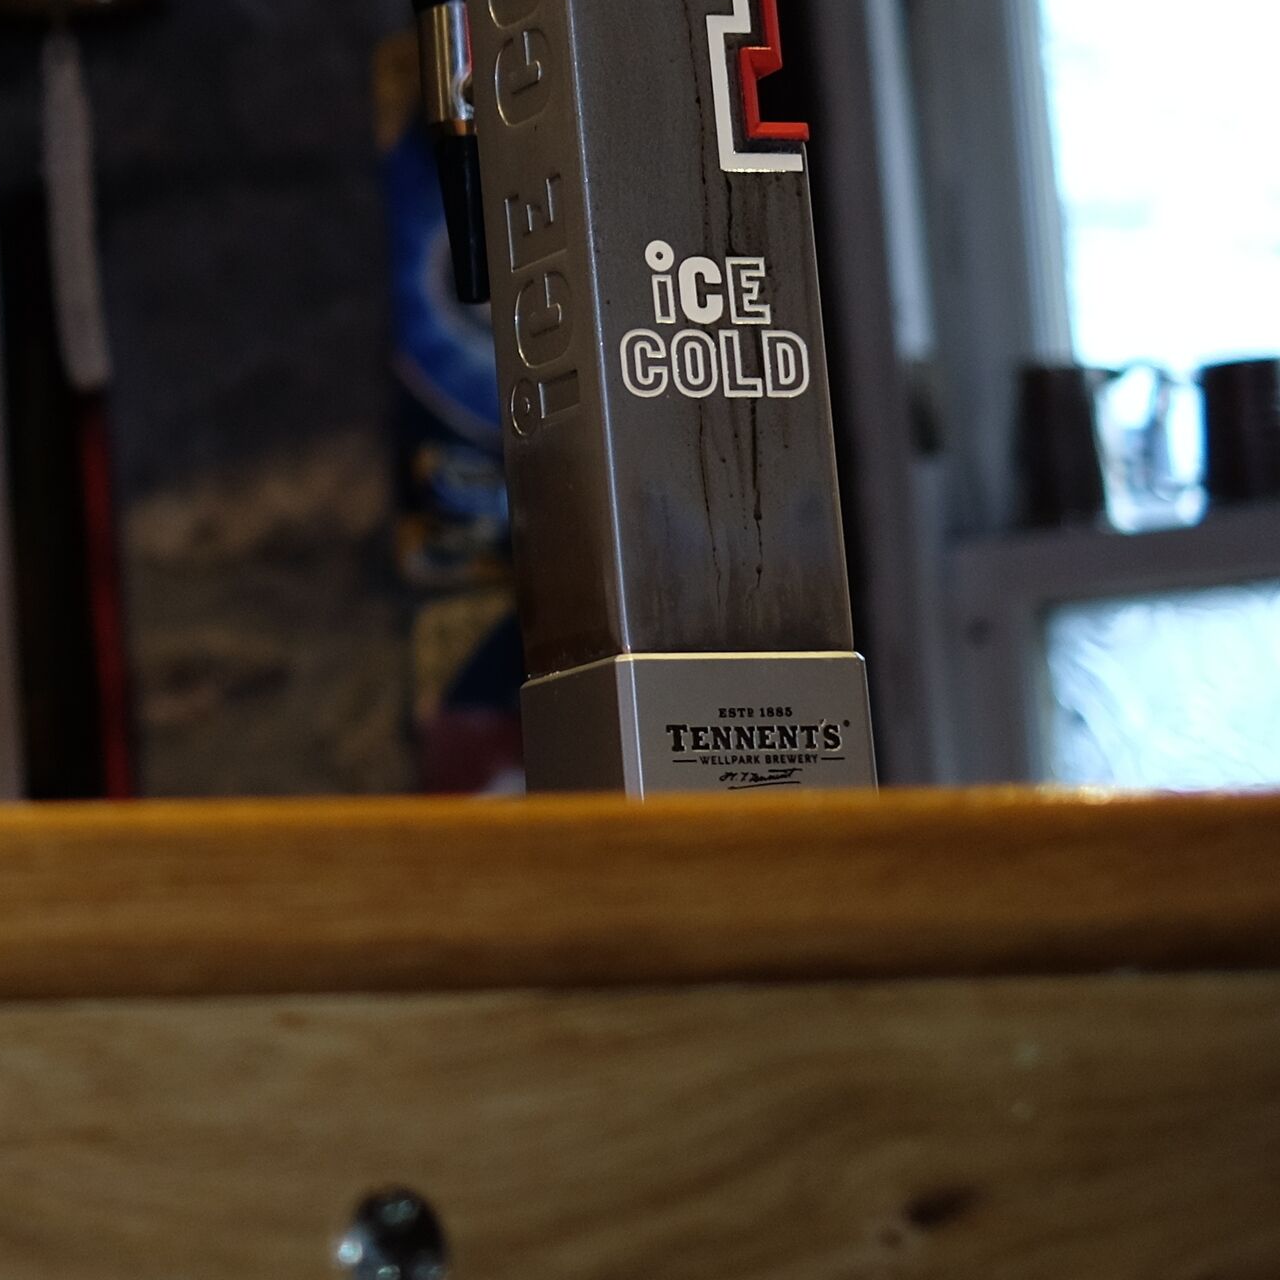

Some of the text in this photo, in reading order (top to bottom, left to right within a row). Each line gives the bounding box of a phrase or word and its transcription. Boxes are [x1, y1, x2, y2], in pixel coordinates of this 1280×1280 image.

[619, 328, 811, 398] COLD
[759, 706, 793, 717] 1885
[665, 719, 842, 752] TENNENT'S
[699, 753, 819, 765] WELLPARK BREWERY
